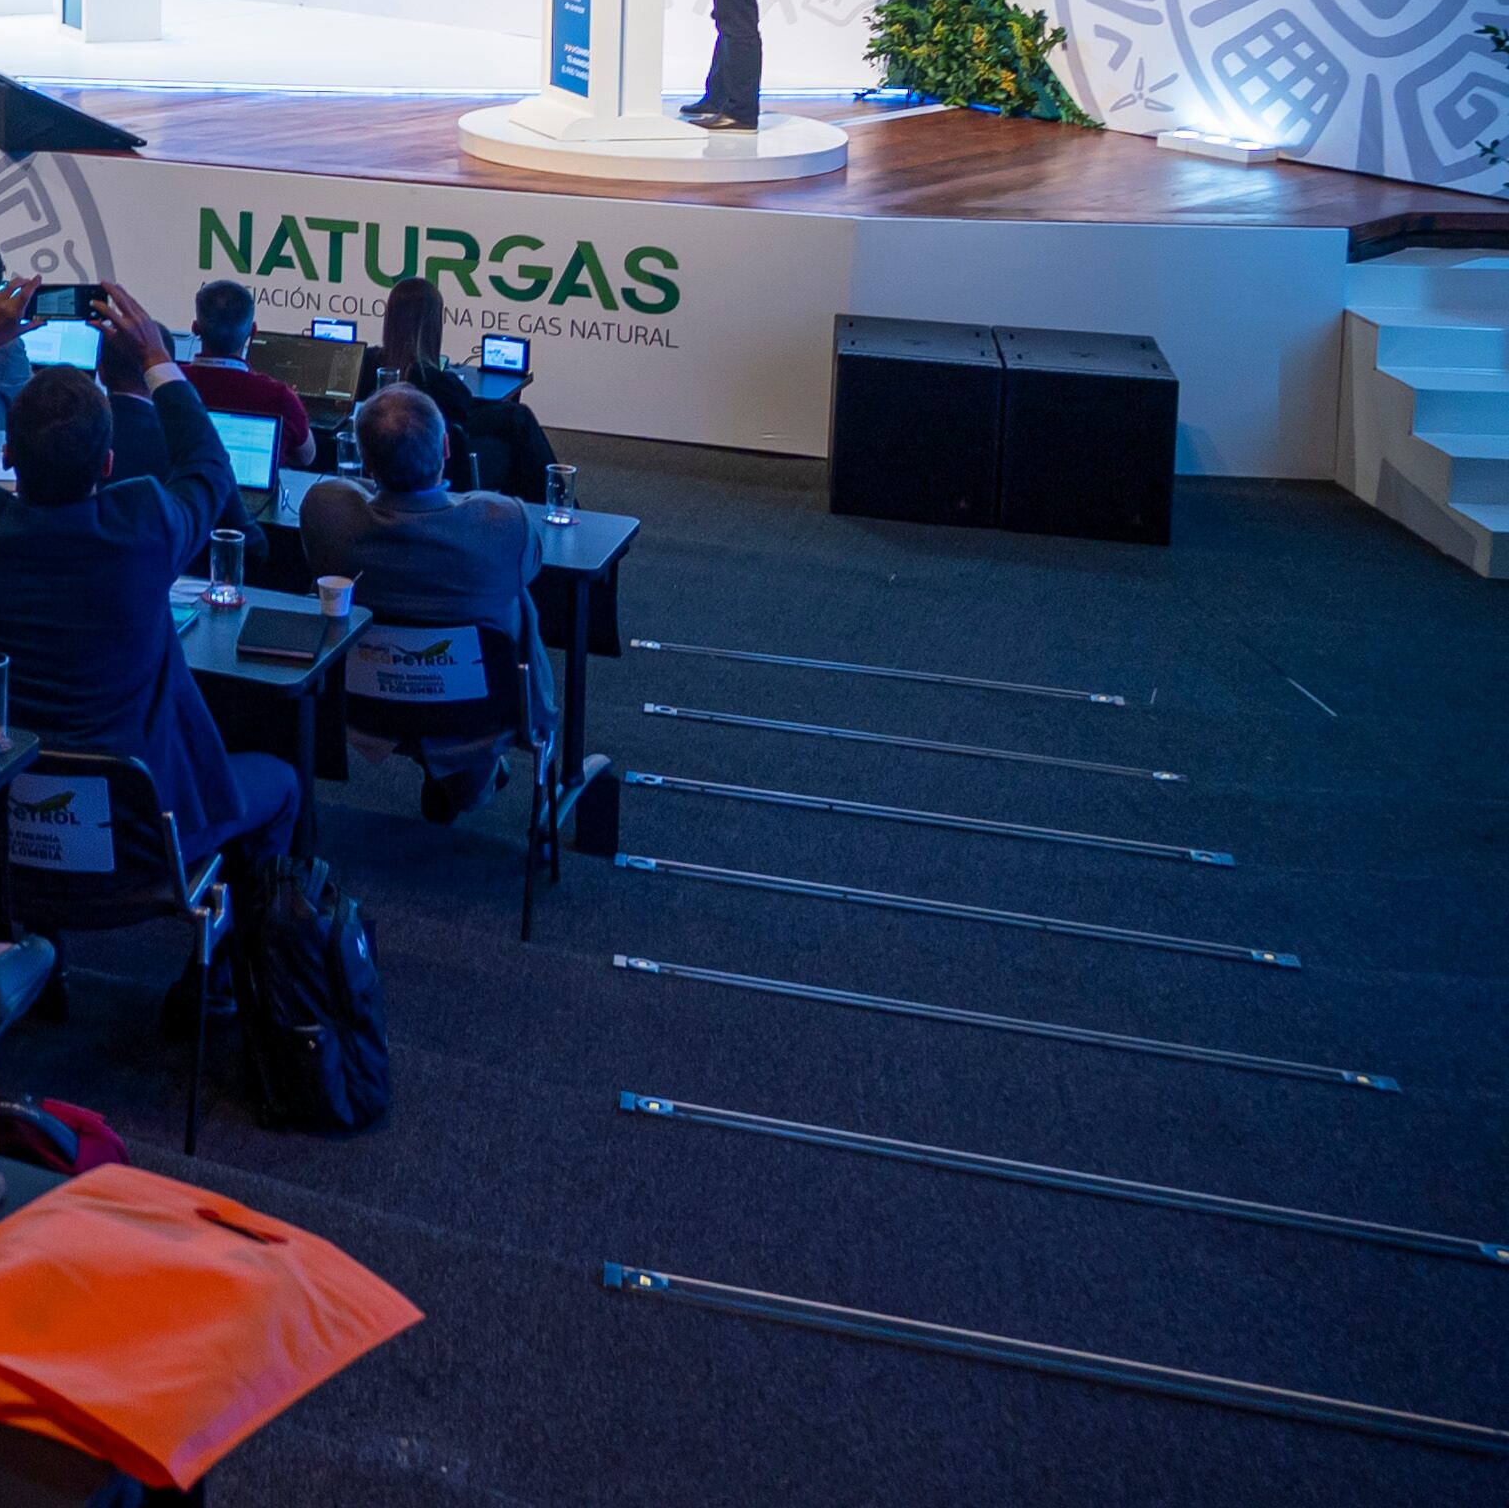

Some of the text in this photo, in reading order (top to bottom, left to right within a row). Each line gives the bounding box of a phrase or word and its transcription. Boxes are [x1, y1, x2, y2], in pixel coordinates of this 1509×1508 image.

[198, 206, 681, 316] NATURGAS
[481, 311, 511, 331] DE
[518, 315, 563, 337] GAS
[570, 320, 680, 349] NATURAL
